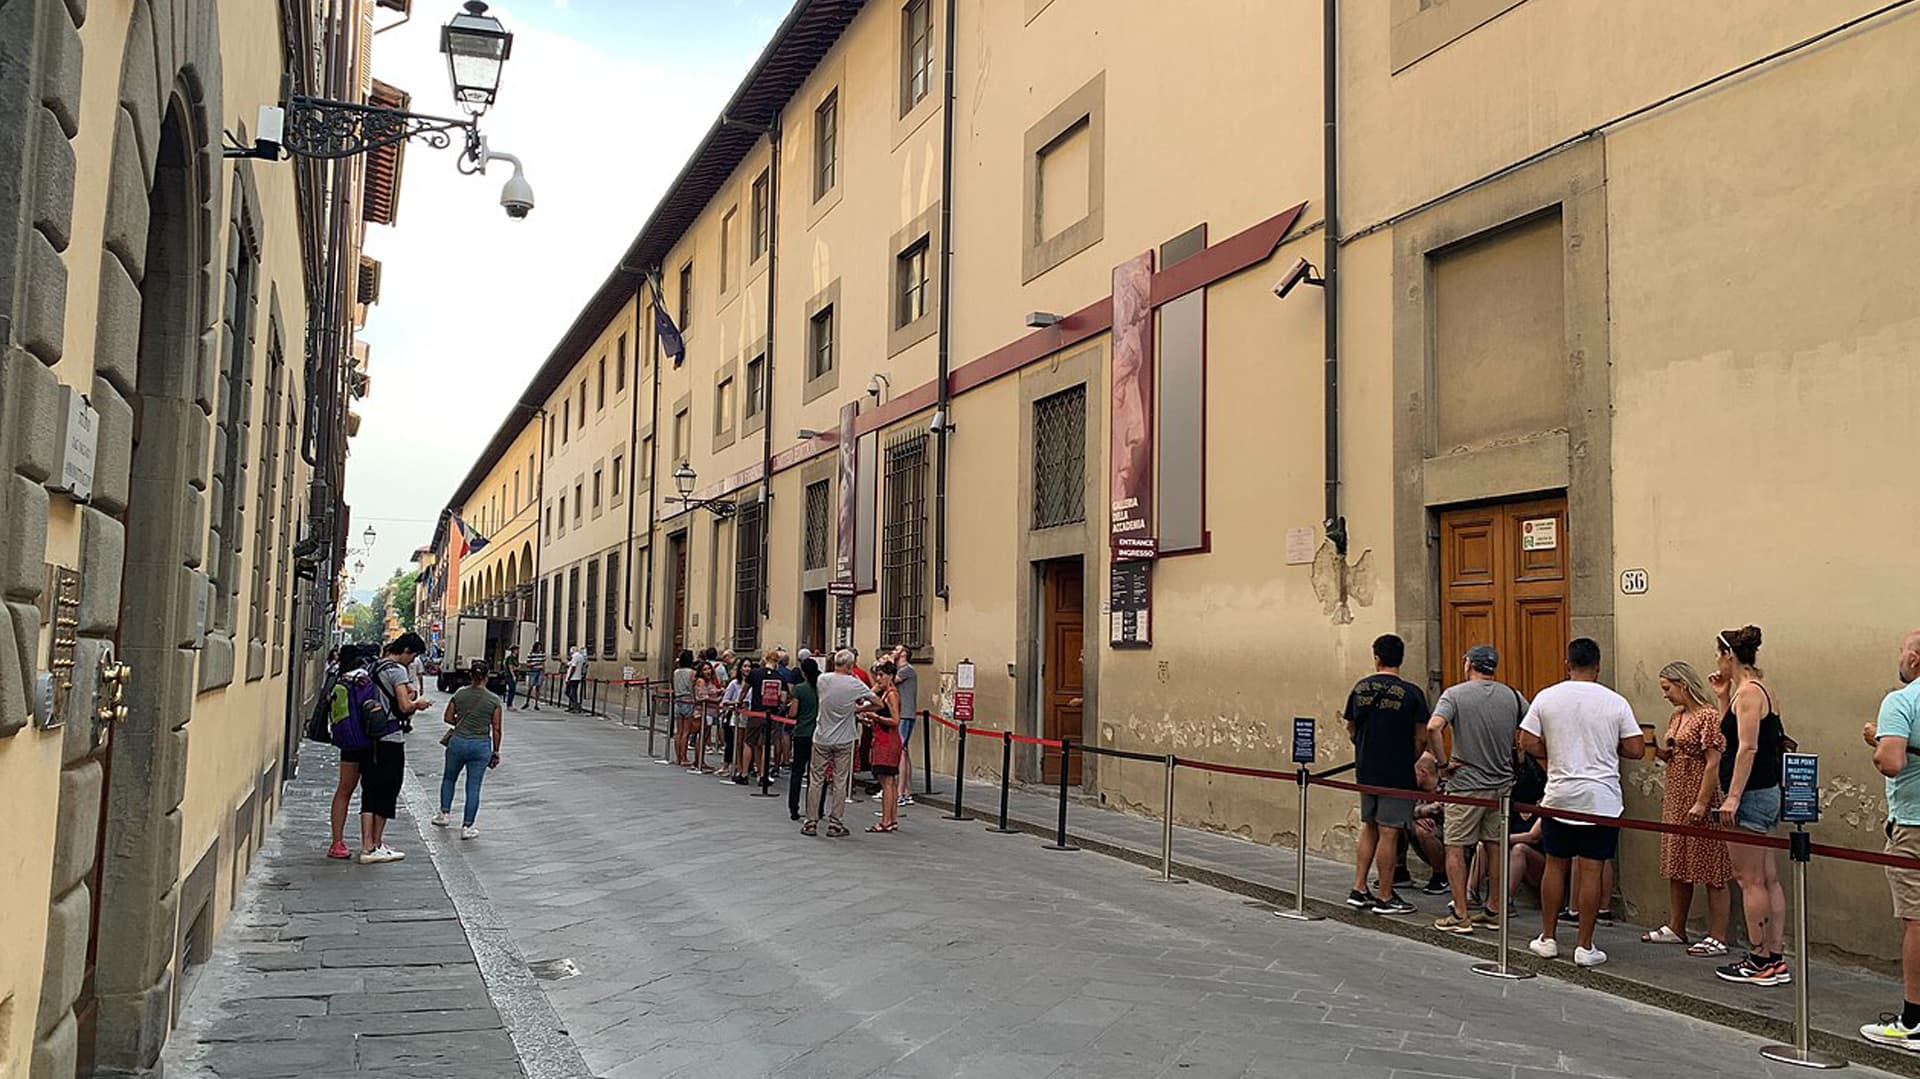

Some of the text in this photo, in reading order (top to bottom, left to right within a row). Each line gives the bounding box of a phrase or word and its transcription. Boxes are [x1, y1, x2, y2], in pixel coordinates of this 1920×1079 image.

[1119, 538, 1154, 547] ENTRANCE
[1118, 549, 1154, 557] INGRESSO
[1624, 572, 1644, 590] 56
